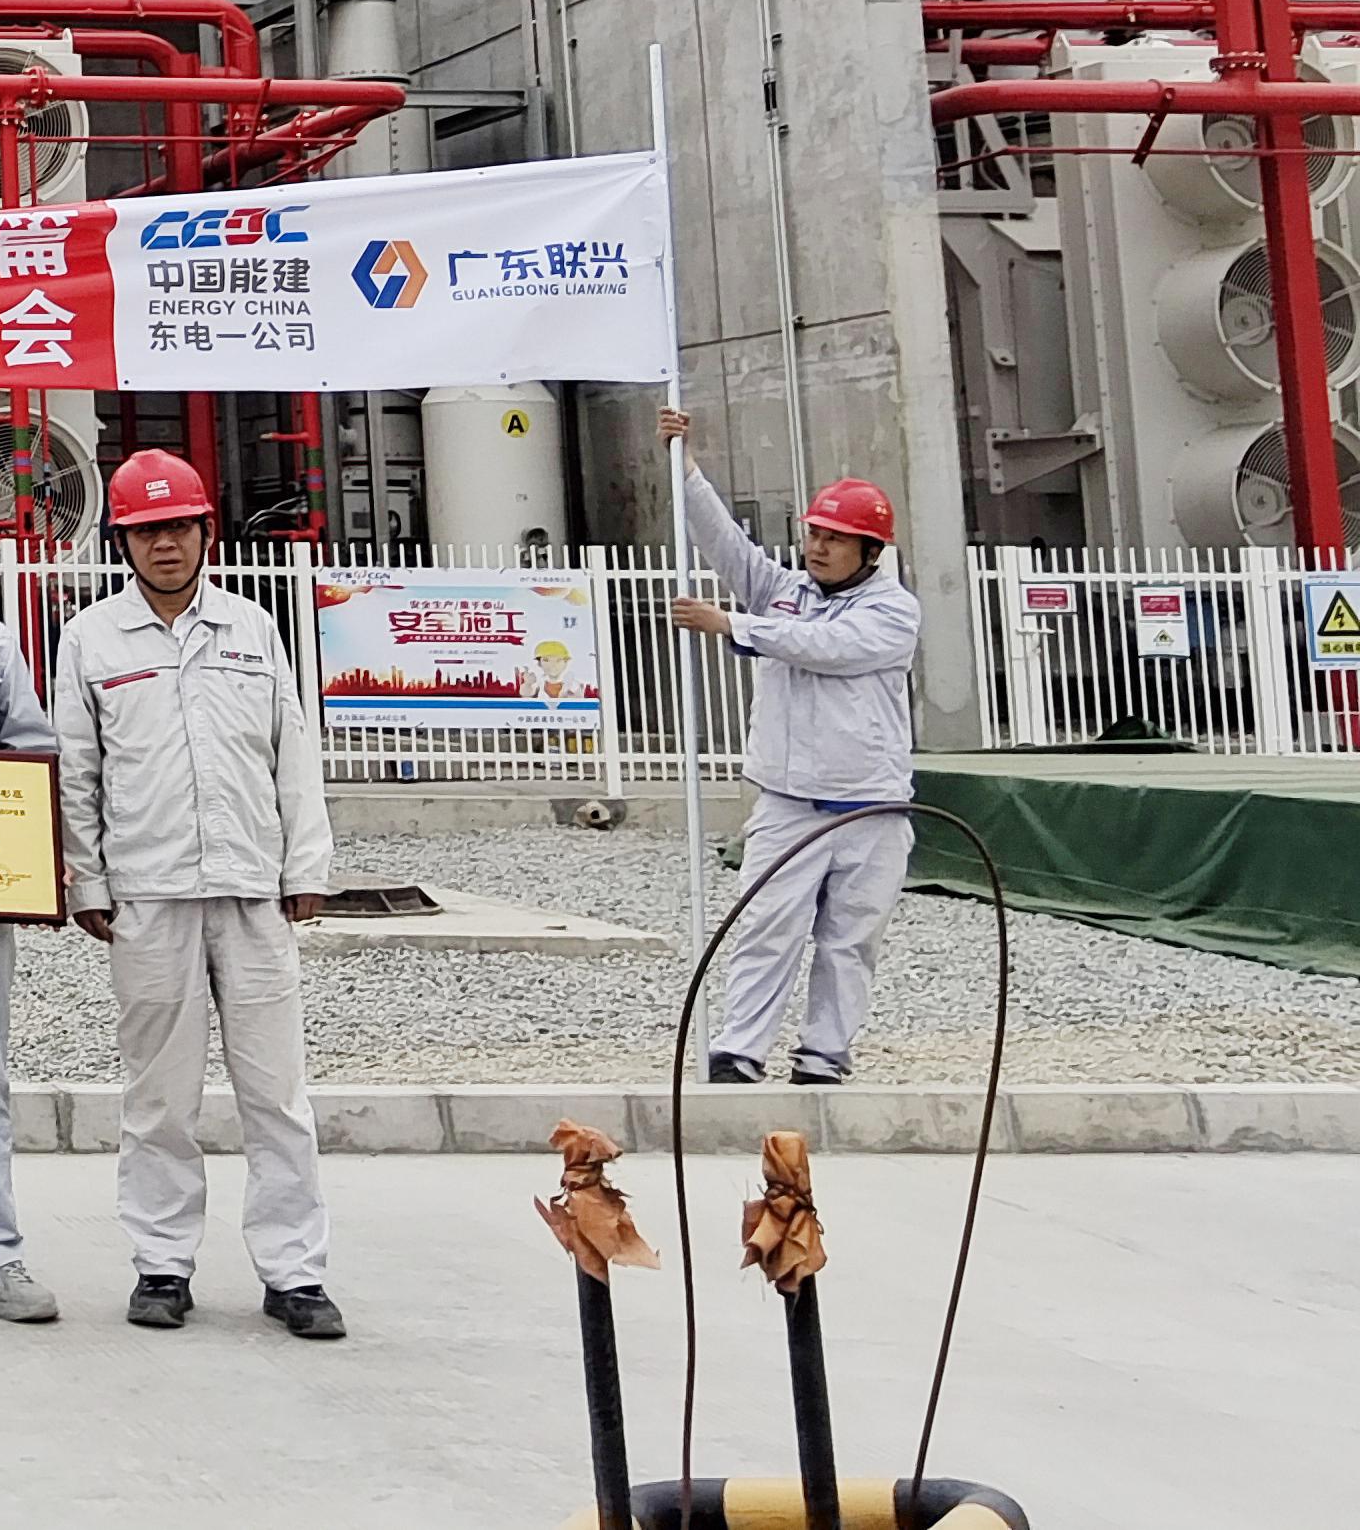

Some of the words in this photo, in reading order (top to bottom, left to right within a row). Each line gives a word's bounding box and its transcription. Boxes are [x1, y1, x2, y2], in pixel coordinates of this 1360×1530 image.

[448, 241, 629, 286] 广东联兴
[147, 258, 311, 293] 中国能建
[452, 284, 559, 301] GUANGDONG
[565, 283, 627, 296] LIANXING
[148, 300, 236, 315] ENERGY
[244, 300, 311, 315] CHINA
[148, 321, 316, 351] 东电一公司
[507, 414, 525, 433] A
[388, 611, 528, 633] 安全施工
